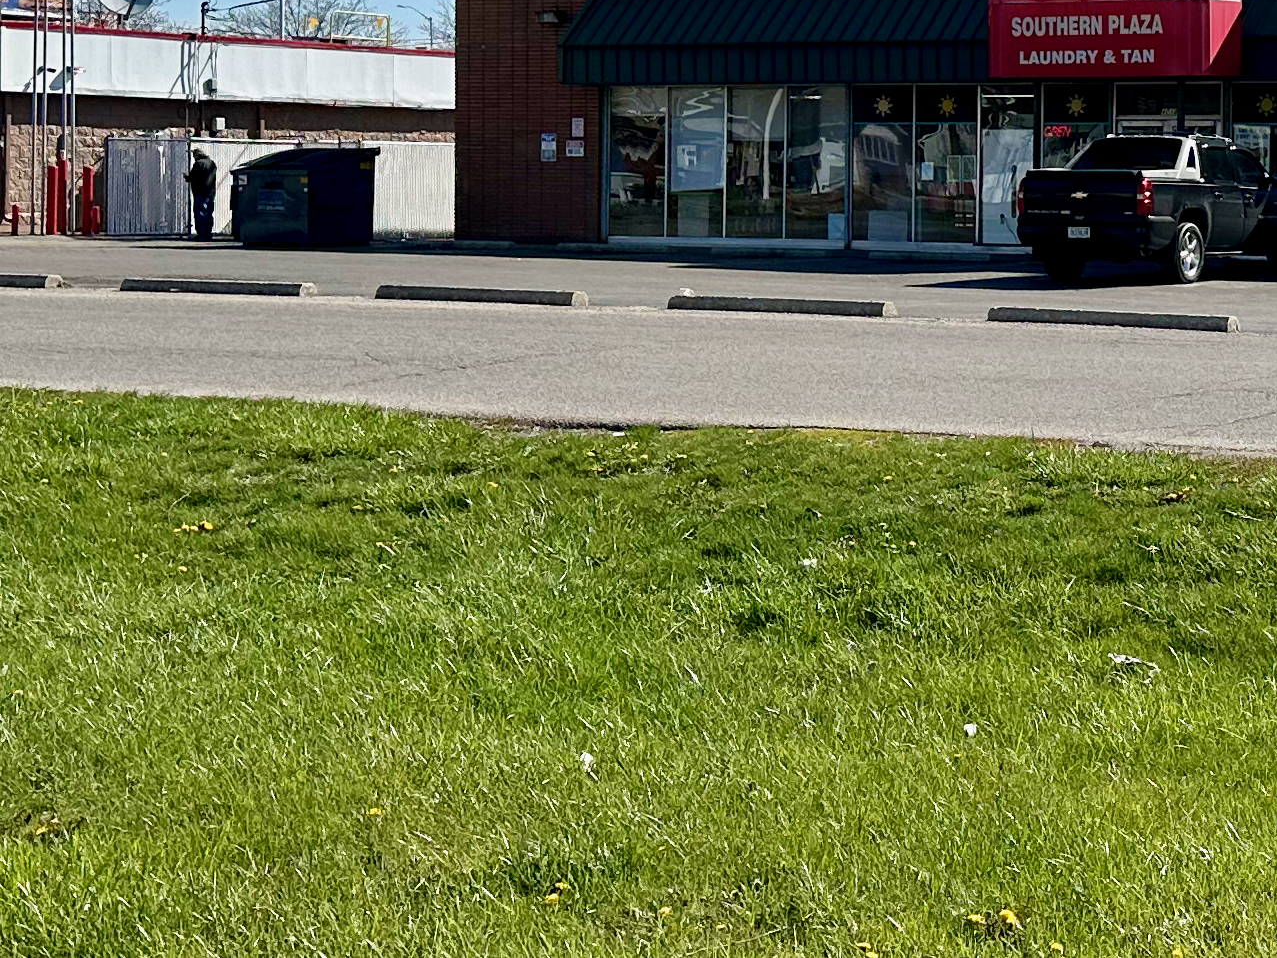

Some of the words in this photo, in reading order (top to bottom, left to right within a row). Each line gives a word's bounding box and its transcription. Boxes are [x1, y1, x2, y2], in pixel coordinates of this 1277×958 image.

[1011, 15, 1102, 37] SOUTHERN
[1108, 14, 1163, 35] PLAZA
[1019, 50, 1098, 65] LAUNDRY
[1103, 50, 1116, 63] &
[1121, 49, 1155, 63] TAN
